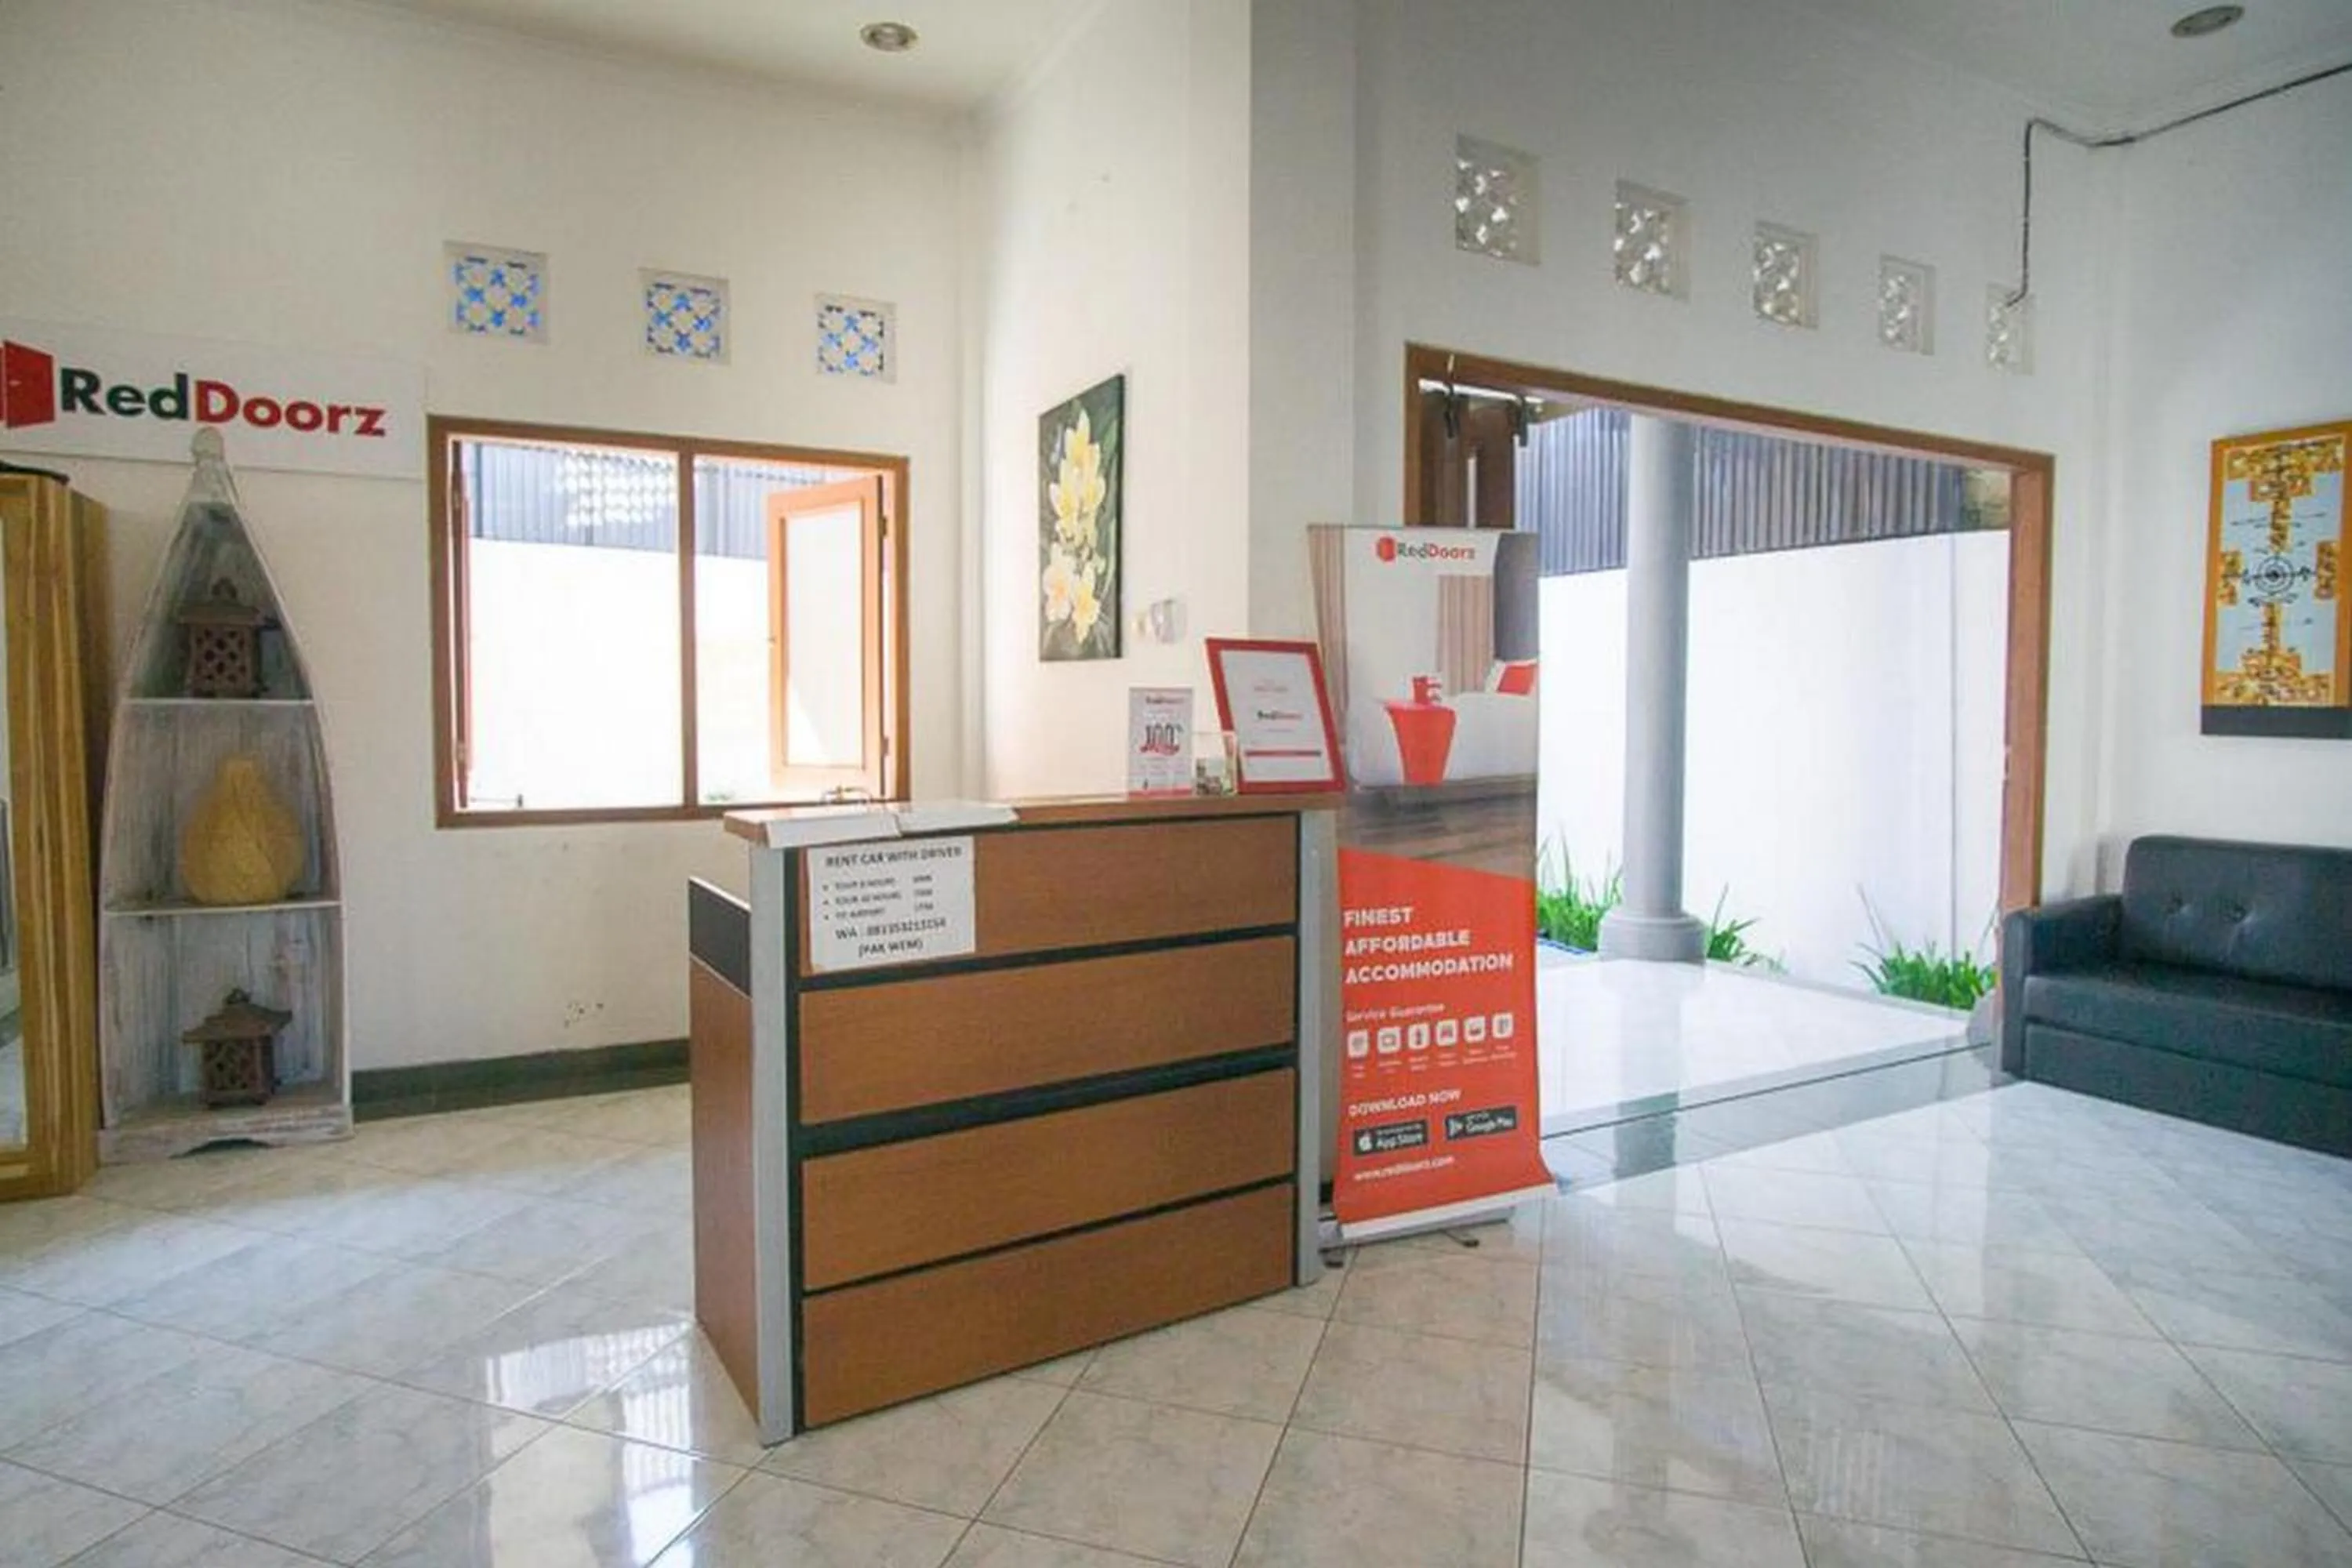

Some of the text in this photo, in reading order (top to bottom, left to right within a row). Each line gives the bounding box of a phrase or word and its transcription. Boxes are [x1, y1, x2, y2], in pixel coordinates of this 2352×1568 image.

[60, 367, 386, 437] RedDoorz
[1397, 543, 1475, 559] RedDoorz
[826, 854, 857, 867] RENT
[860, 851, 884, 863] CAR
[886, 850, 917, 862] WITH
[1343, 906, 1414, 927] FINEST
[1345, 929, 1471, 956] AFFORDABLE
[1345, 953, 1513, 984] ACCOMMODATION
[1348, 1089, 1461, 1117] DOWNLOAD NOW
